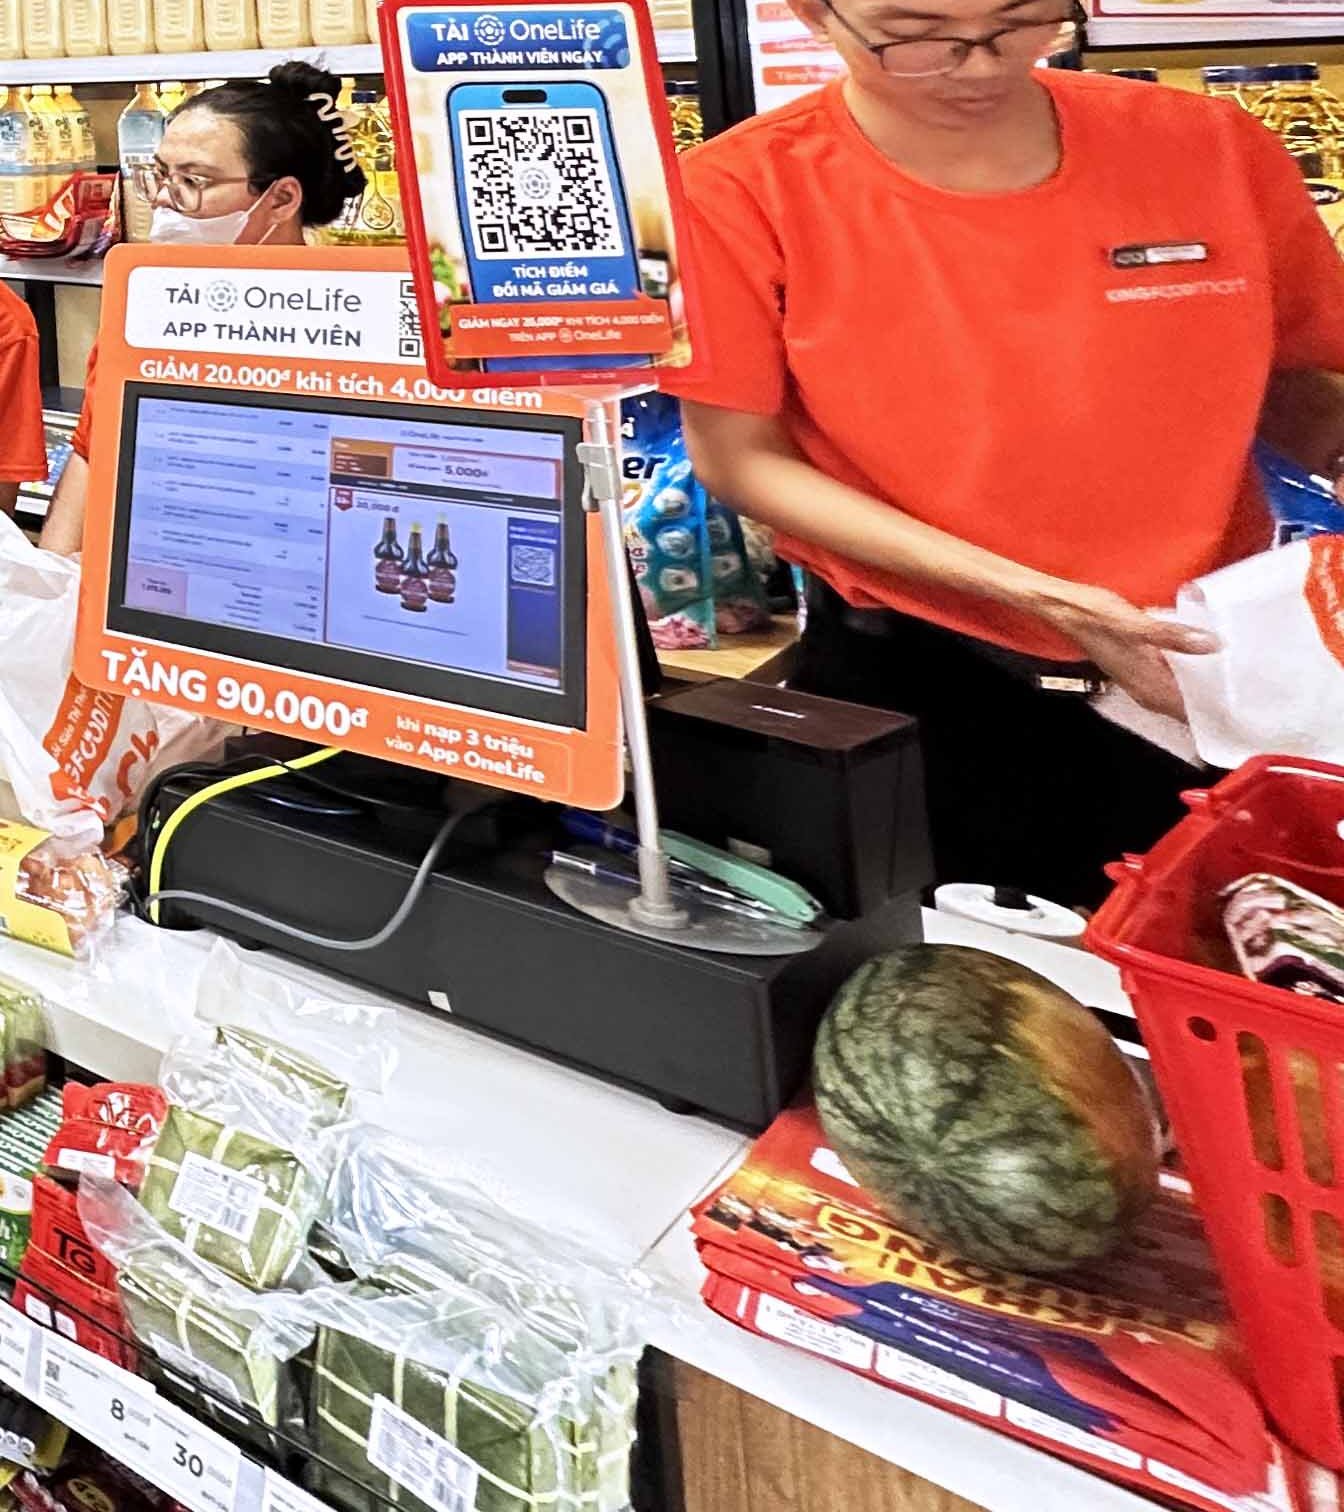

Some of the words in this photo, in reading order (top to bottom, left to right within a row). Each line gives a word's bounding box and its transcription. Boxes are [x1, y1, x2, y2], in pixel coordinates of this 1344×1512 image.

[430, 18, 470, 42] TẢI
[509, 18, 602, 41] OneLife
[437, 51, 468, 65] APP
[470, 47, 524, 65] THÀNH
[525, 47, 561, 64] VIÊN
[562, 50, 603, 64] NGAY
[512, 263, 546, 279] TÍCH
[548, 261, 588, 279] ĐIỂM
[165, 284, 200, 306] TẢI
[244, 286, 362, 313] OneLife
[520, 280, 545, 296] MÃ
[547, 279, 588, 296] GIẢM
[589, 278, 620, 295] GIÁ
[163, 321, 207, 339] APP
[213, 318, 296, 344] THÀNH
[303, 323, 362, 347] VIÊN
[140, 357, 199, 382] GIẢM
[205, 363, 292, 388] 20.000đ
[296, 366, 331, 392] khi
[337, 374, 384, 398] tích
[100, 646, 207, 703] TẶNG
[216, 676, 370, 738] 90.000đ
[396, 714, 421, 734] khi
[424, 721, 462, 745] nạp
[465, 727, 480, 747] 3
[483, 733, 535, 761] triệu
[384, 734, 415, 755] vào
[417, 740, 458, 766] App
[462, 751, 545, 785] OneLife
